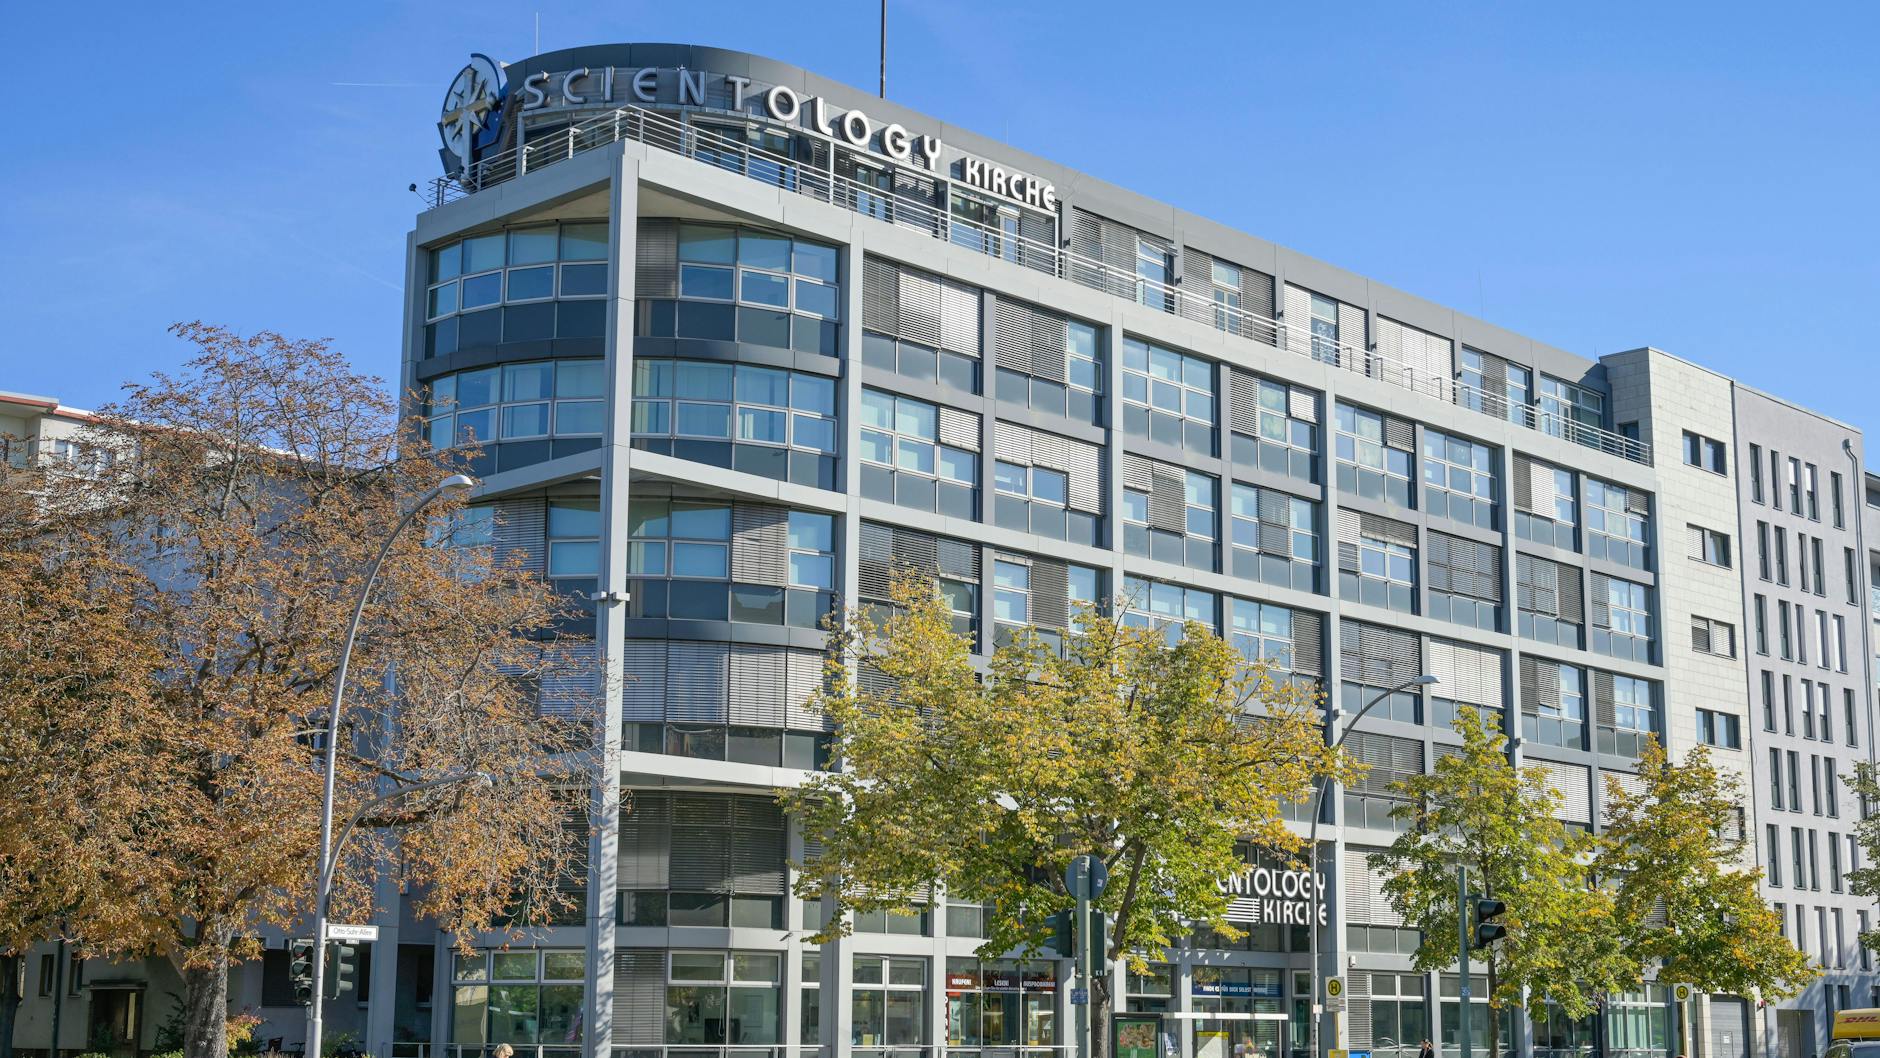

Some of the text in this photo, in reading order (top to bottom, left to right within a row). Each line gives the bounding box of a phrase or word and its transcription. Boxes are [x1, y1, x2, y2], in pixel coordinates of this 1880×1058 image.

[523, 65, 942, 172] SCIENTOLOGY
[961, 157, 1056, 212] KIRCHE
[333, 927, 372, 936] Otto-Suhr-Allee
[1330, 983, 1338, 993] H
[1845, 1015, 1879, 1023] DHL
